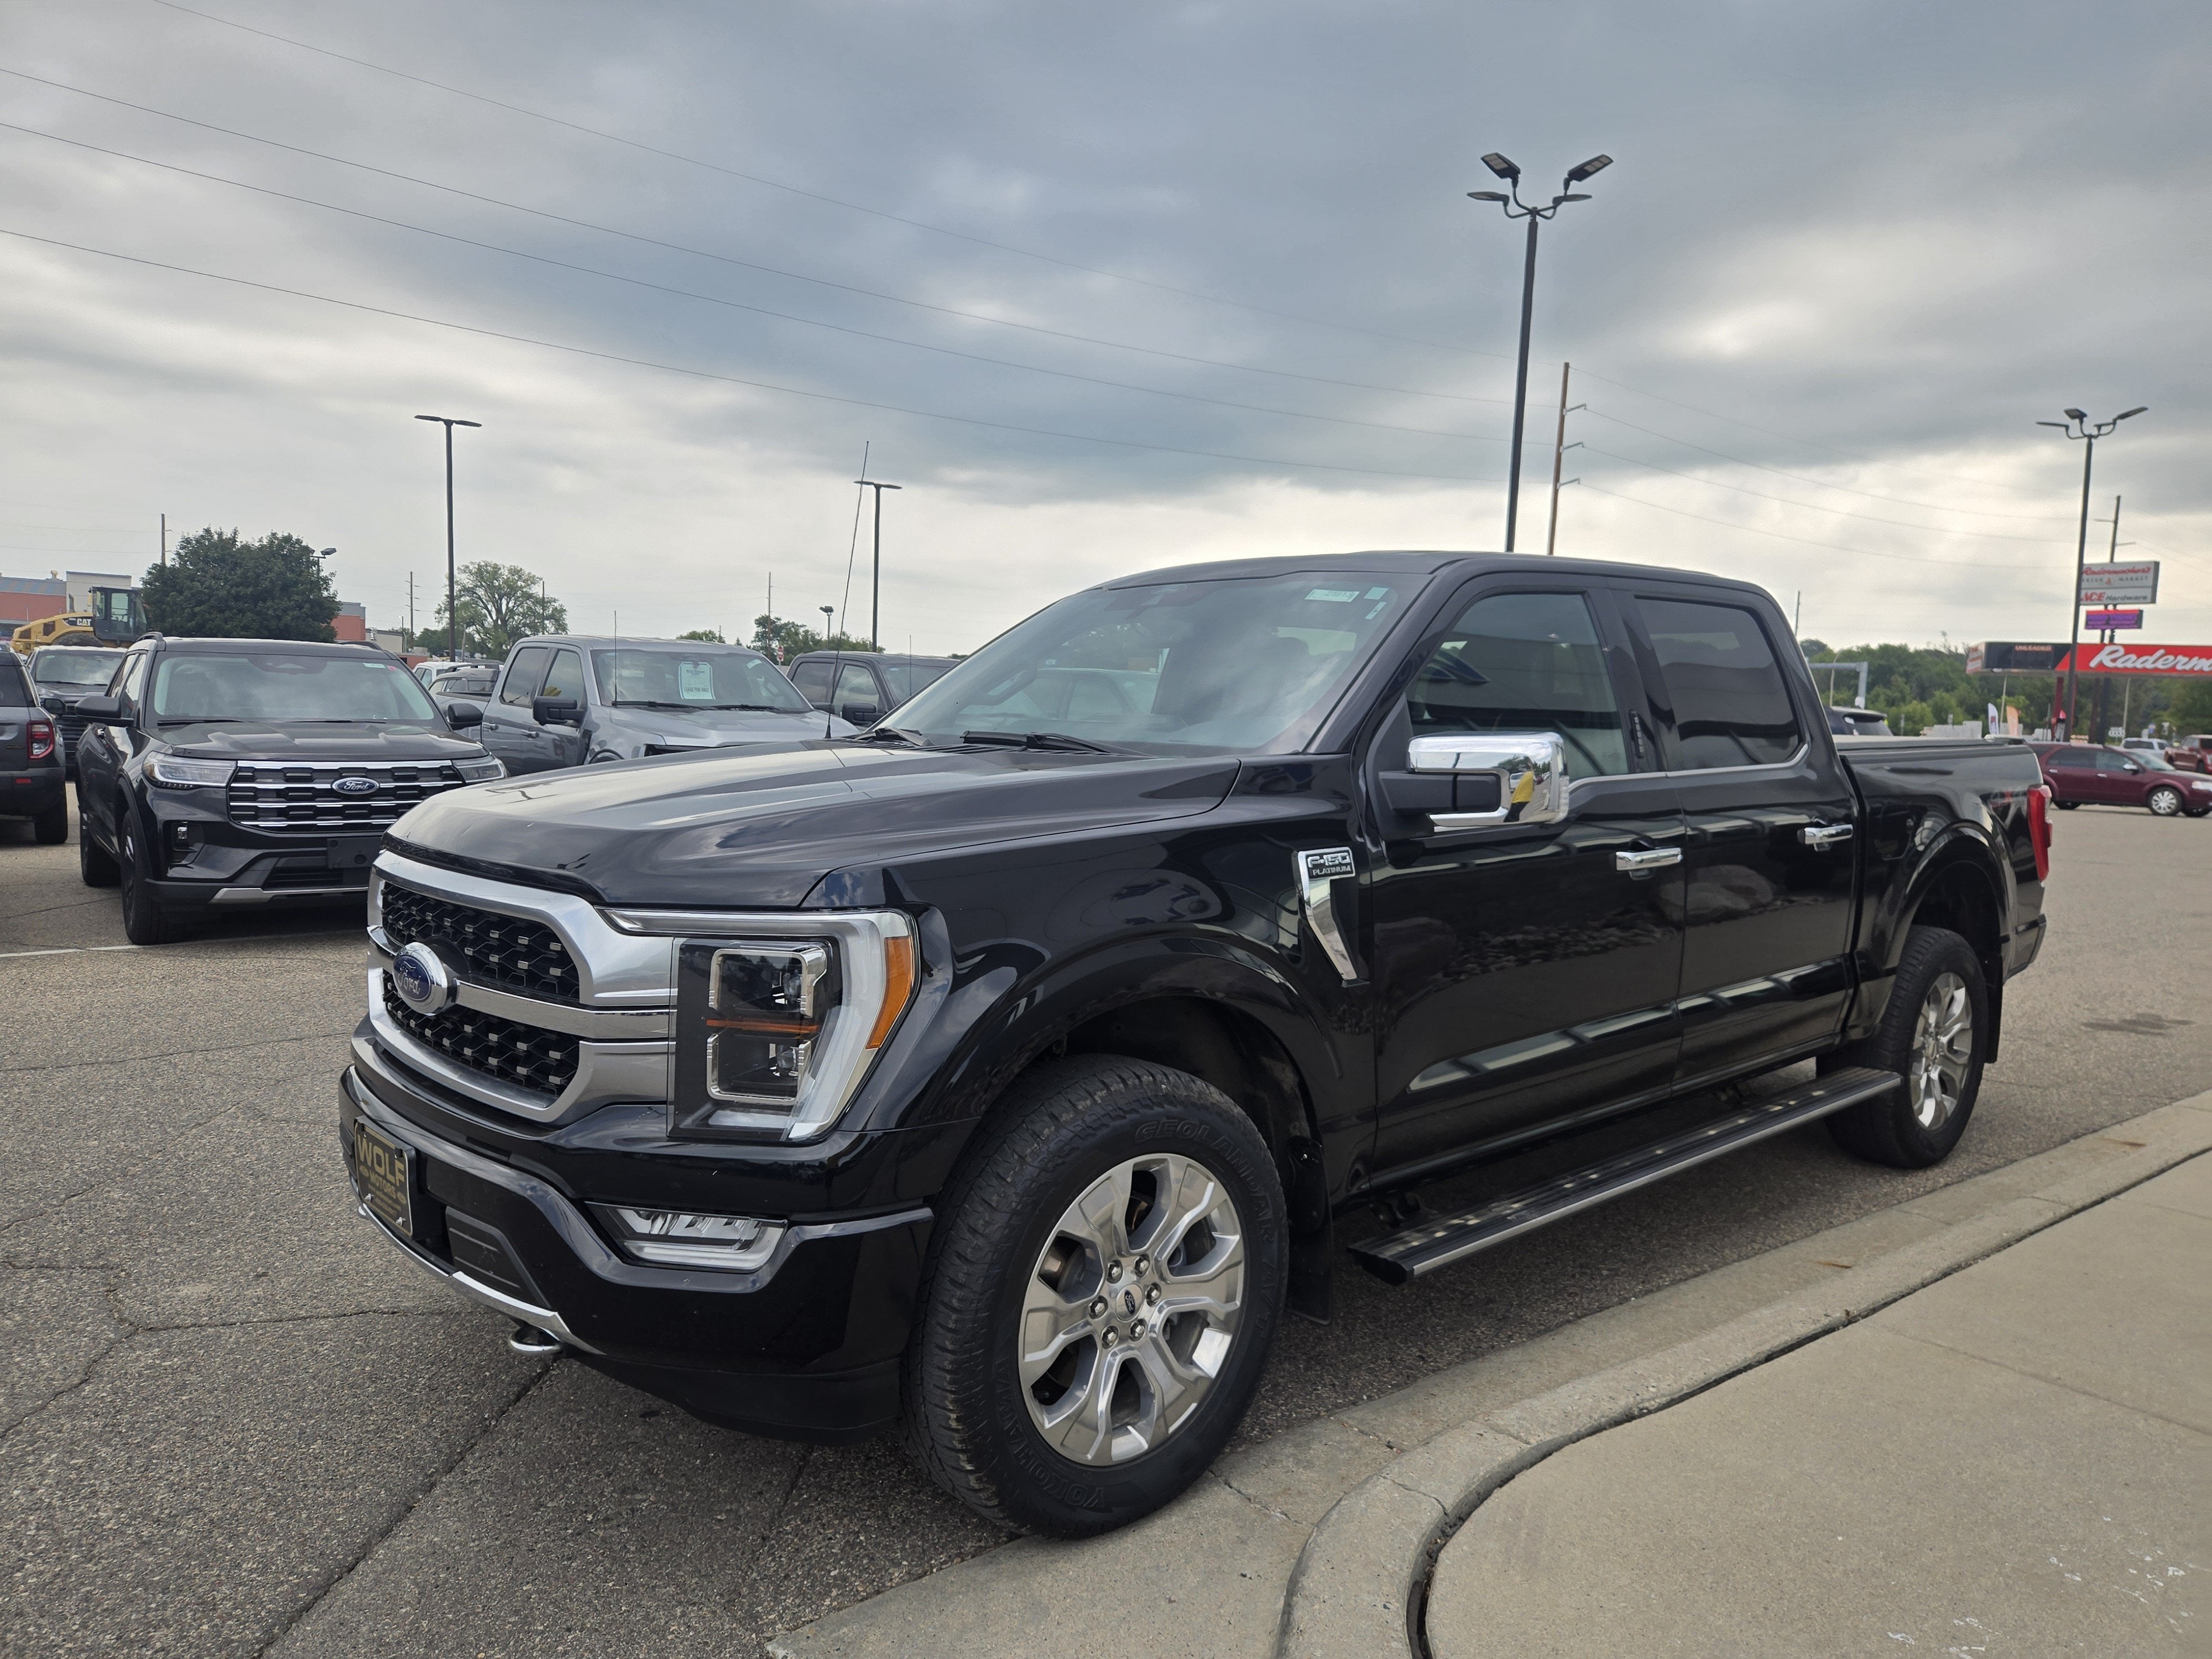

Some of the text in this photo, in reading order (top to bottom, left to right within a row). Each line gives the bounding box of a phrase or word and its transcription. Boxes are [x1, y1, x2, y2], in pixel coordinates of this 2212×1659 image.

[343, 781, 369, 790] Ford
[1307, 852, 1351, 868] F-150
[1312, 865, 1351, 876] PLATINUM
[398, 961, 422, 995] Ford
[357, 1134, 405, 1187] WOLF
[369, 1169, 397, 1199] MOTORS
[1135, 1119, 1275, 1241] GEOLANDAR
[1125, 1294, 1134, 1312] Ford
[994, 1357, 1105, 1507] YOKOHAMA
